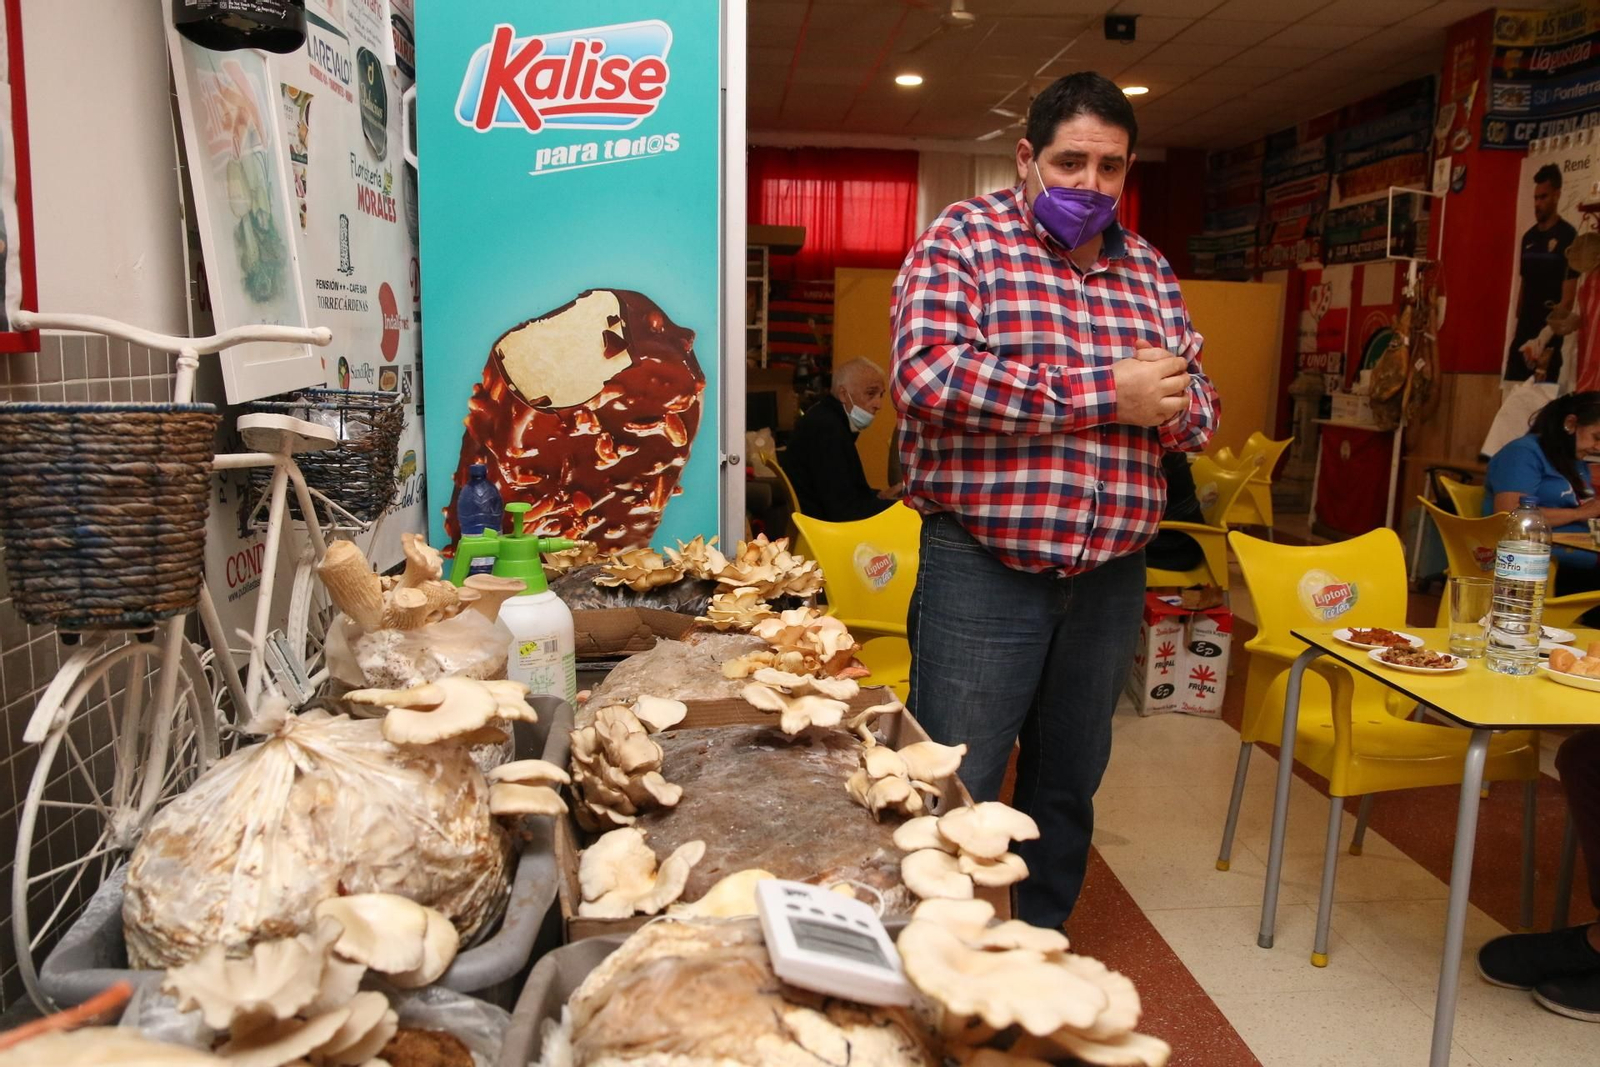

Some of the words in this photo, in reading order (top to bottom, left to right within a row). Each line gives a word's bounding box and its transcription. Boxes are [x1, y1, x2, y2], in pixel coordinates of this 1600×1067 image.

[1529, 40, 1593, 75] Llagostera
[475, 26, 667, 131] Kalise
[1514, 121, 1538, 140] CF
[535, 141, 598, 171] para
[1563, 154, 1591, 173] René
[357, 183, 397, 223] MORALES
[317, 295, 369, 312] TORRECÁRDENAS
[866, 558, 890, 575] Lipton
[1315, 588, 1348, 604] Lipton
[1155, 660, 1175, 670] FRUPAL
[1188, 683, 1216, 694] FRUPAL
